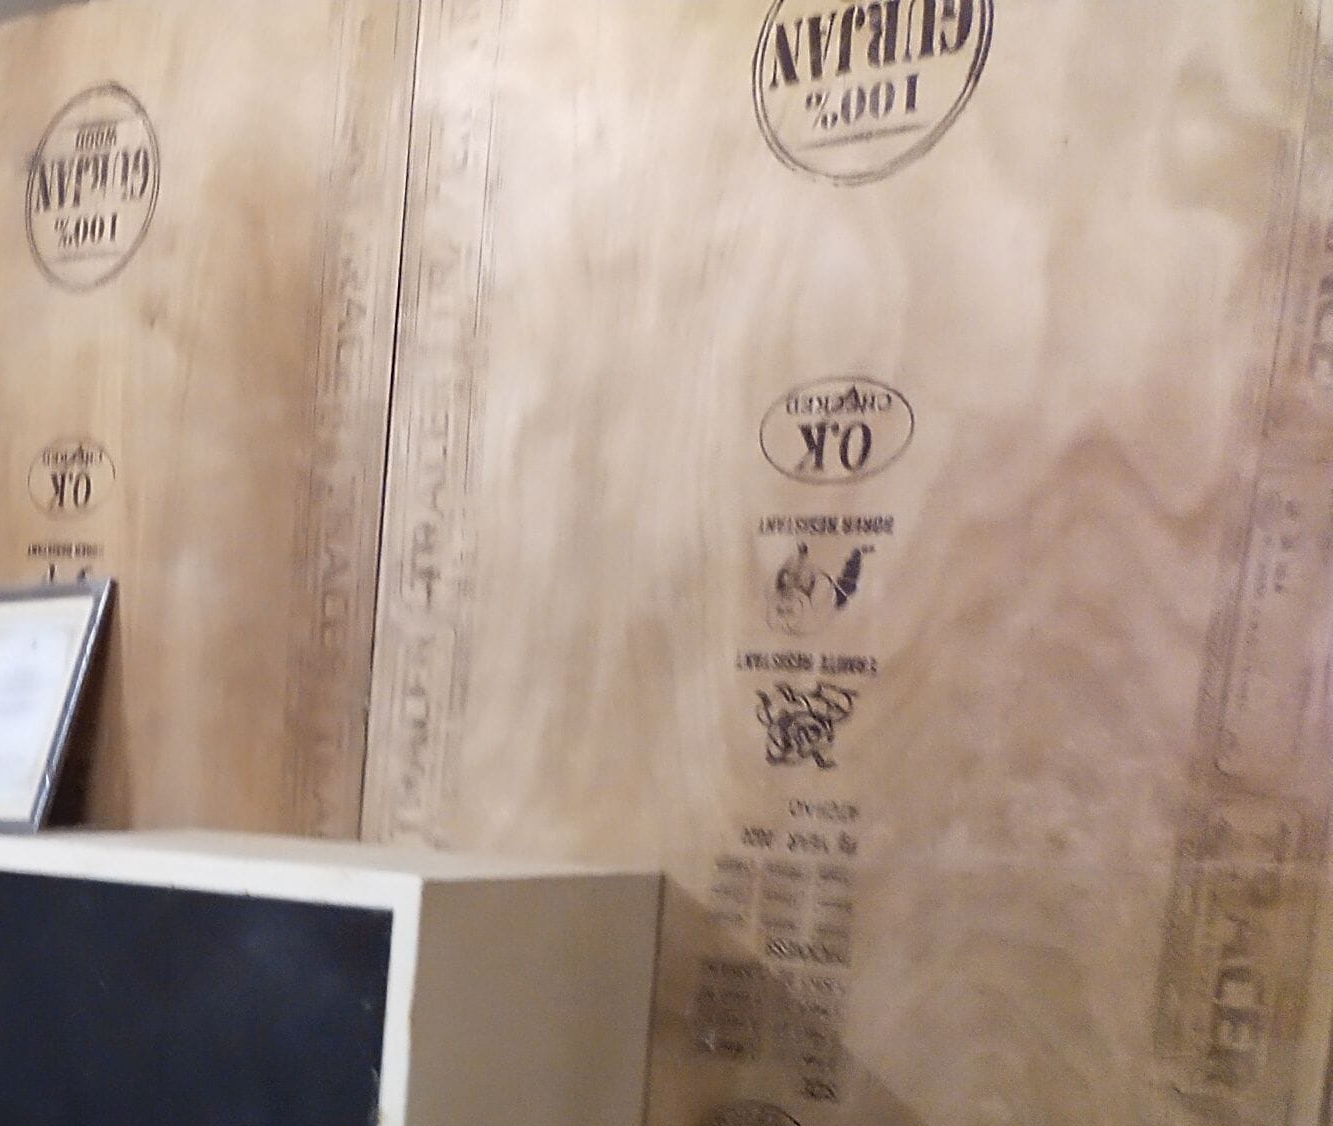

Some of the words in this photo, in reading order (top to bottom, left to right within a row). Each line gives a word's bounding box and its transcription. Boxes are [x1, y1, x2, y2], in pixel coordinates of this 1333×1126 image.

[769, 0, 974, 92] GURJAN
[805, 73, 919, 130] 100%
[34, 149, 150, 214] GURJAN
[54, 212, 118, 249] 100%
